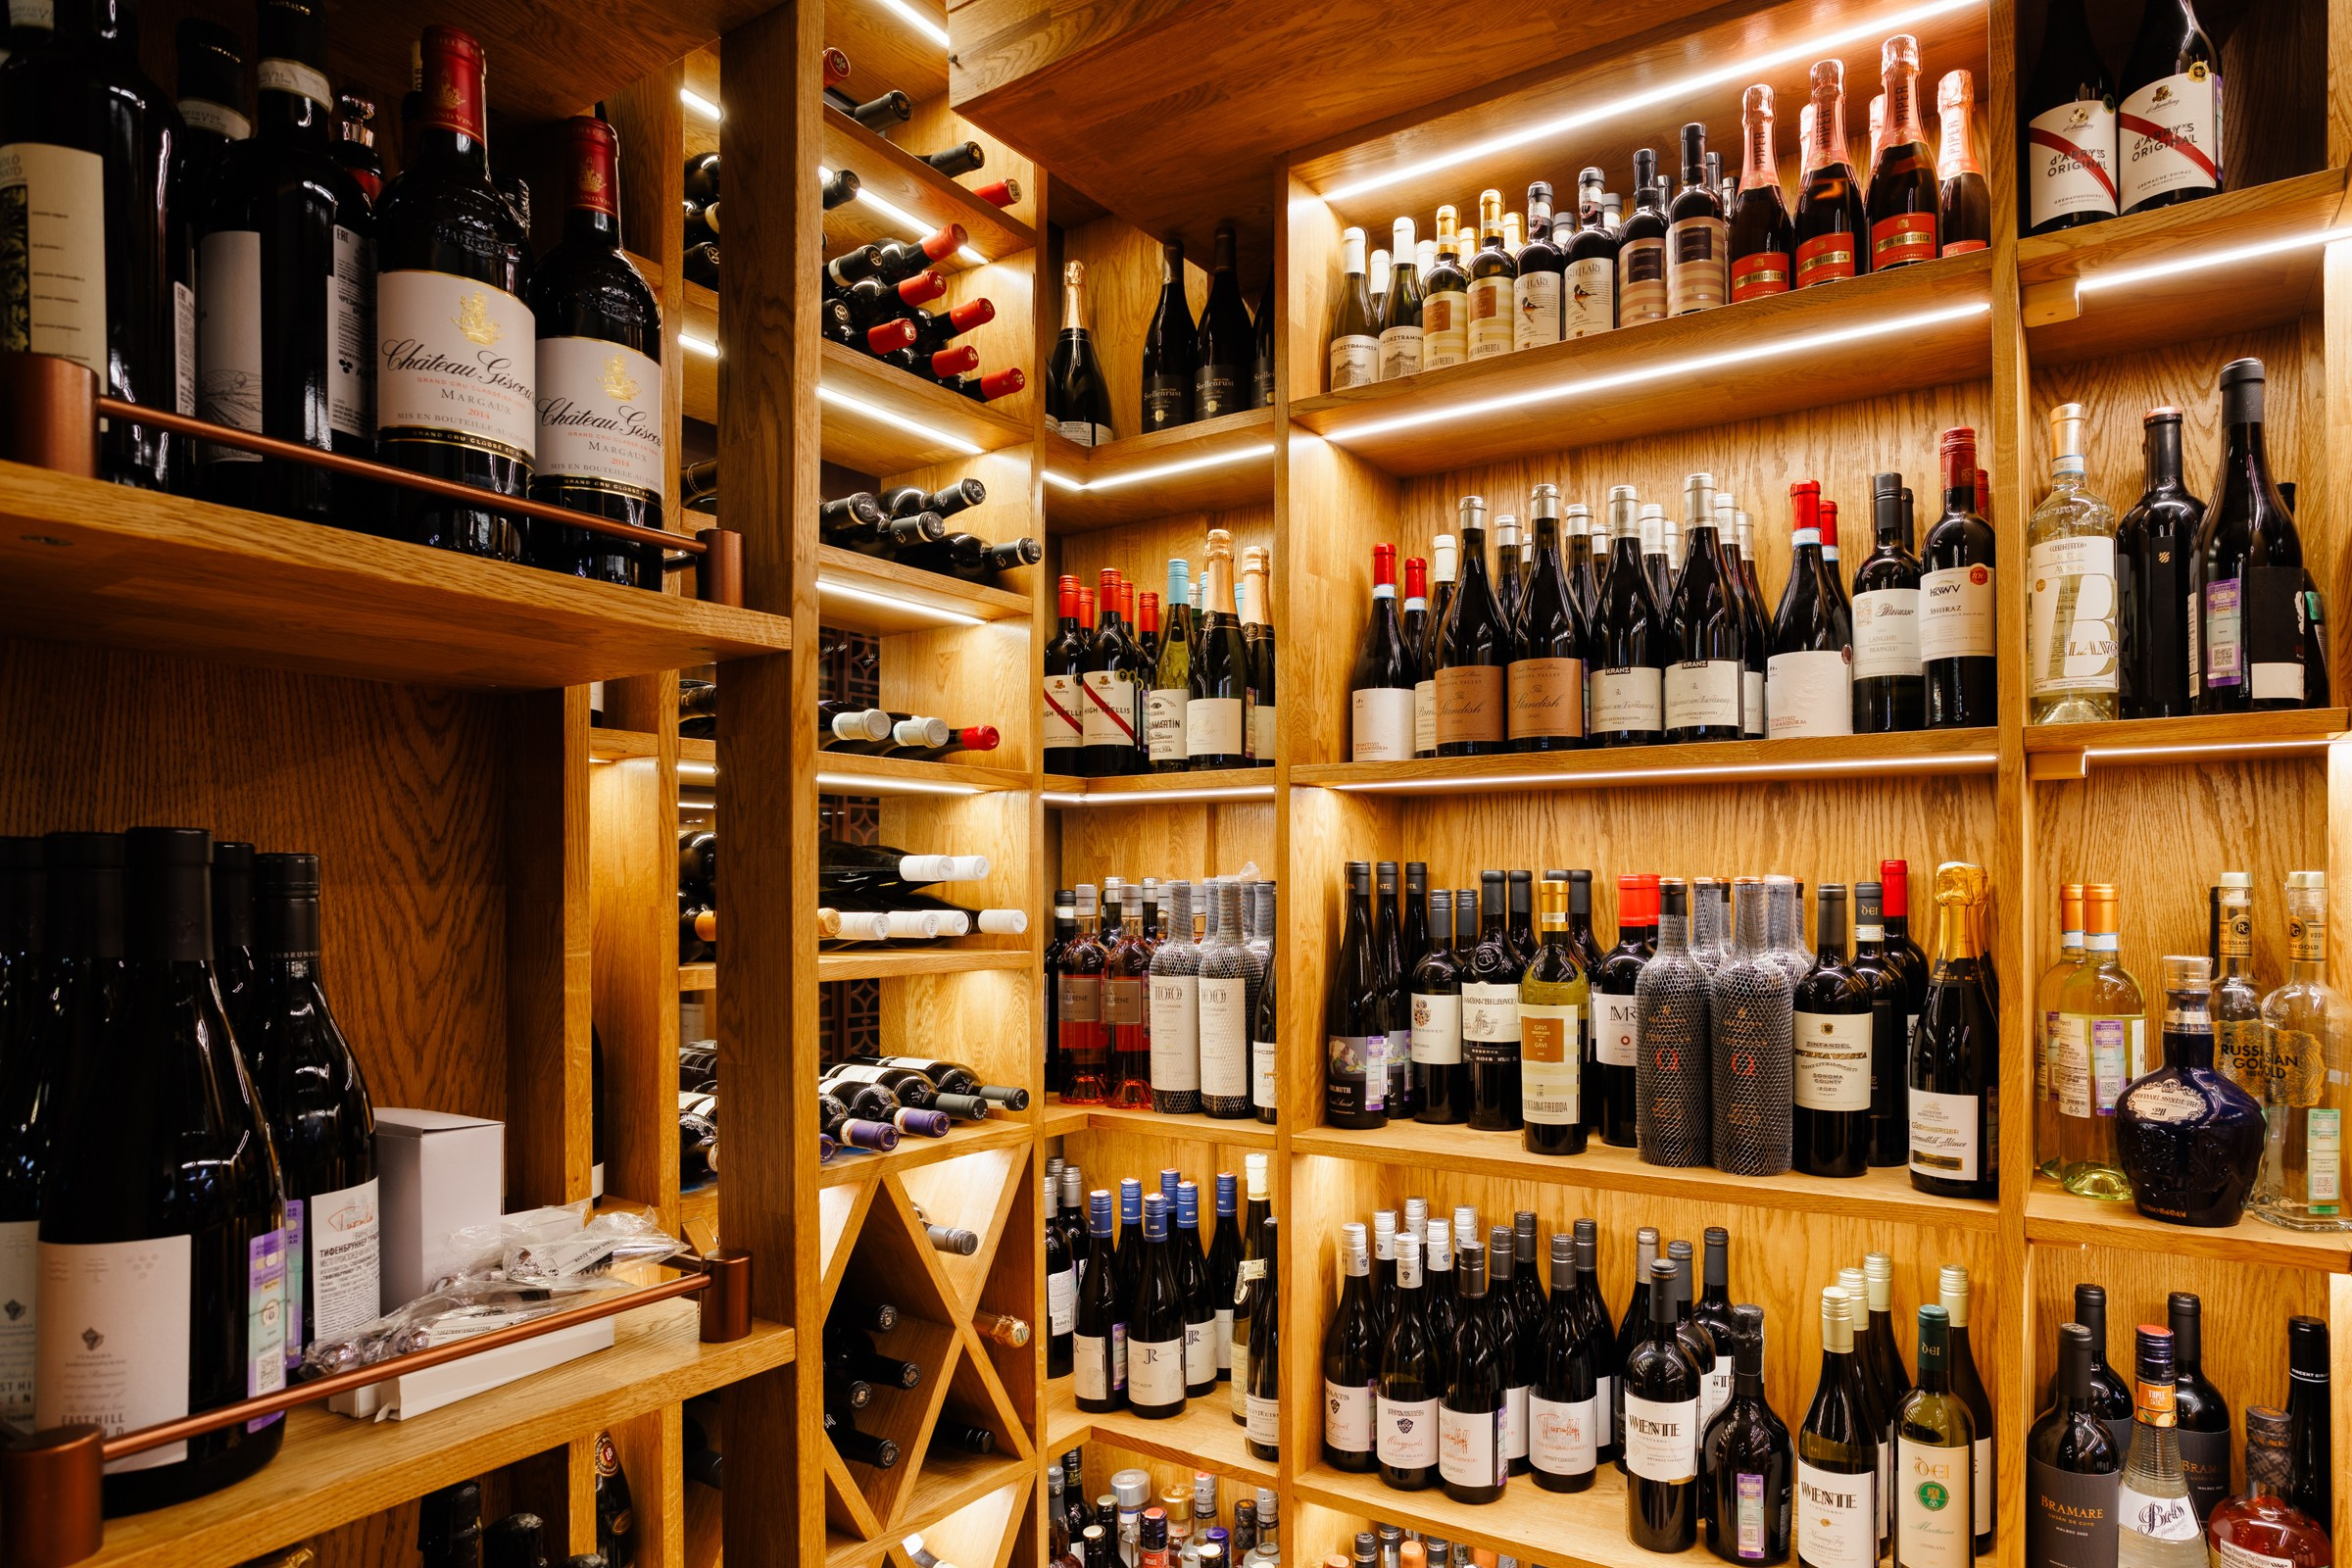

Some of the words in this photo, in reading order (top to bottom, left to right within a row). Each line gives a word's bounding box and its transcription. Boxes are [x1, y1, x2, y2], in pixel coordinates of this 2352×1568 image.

[1895, 85, 1909, 122] PIPER
[1822, 108, 1832, 146] PIPER
[1948, 119, 1960, 155] PIPER
[2133, 122, 2194, 151] d'ARRY'S
[1754, 131, 1766, 166] PIPER
[2132, 133, 2198, 163] ORIGINAL
[2047, 160, 2108, 177] ORIGINAL
[2136, 173, 2168, 190] GRENACHE
[2169, 170, 2192, 178] SHIRAZ
[382, 338, 478, 379] Château
[476, 350, 536, 405] Giscou
[416, 376, 447, 385] GRAND
[450, 380, 468, 389] CRU
[1196, 378, 1235, 392] Stellenrust
[441, 387, 512, 416] MARGAUX
[1144, 390, 1182, 401] Stellenrust
[434, 414, 494, 432] BOUTEILLE
[467, 408, 491, 420] 2014
[536, 397, 618, 431] Château
[447, 433, 466, 442] CRU
[588, 440, 648, 463] MARGAUX
[583, 464, 633, 478] BOUTEILLE
[611, 457, 630, 467] 2014
[1930, 583, 1962, 598] KWV
[1930, 605, 1962, 615] SHIRAZ
[1683, 660, 1708, 668] KRANZ
[1529, 684, 1544, 694] The
[1437, 699, 1488, 717] Standish
[1511, 692, 1565, 711] Standish
[1805, 1040, 1852, 1050] ZINFANDEL
[1655, 1047, 1681, 1073] Q
[1731, 1050, 1757, 1077] Q
[1831, 1051, 1868, 1060] VISTA
[2232, 1056, 2265, 1069] GOL
[2264, 1064, 2287, 1079] OLD
[319, 1238, 368, 1258] ТИФЕНБРУННЕР
[94, 1412, 125, 1425] HILL
[1628, 1413, 1682, 1438] WENTE
[1800, 1481, 1858, 1509] WENTE
[2040, 1494, 2104, 1519] BRAMARE
[2055, 1526, 2076, 1535] MALBEC
